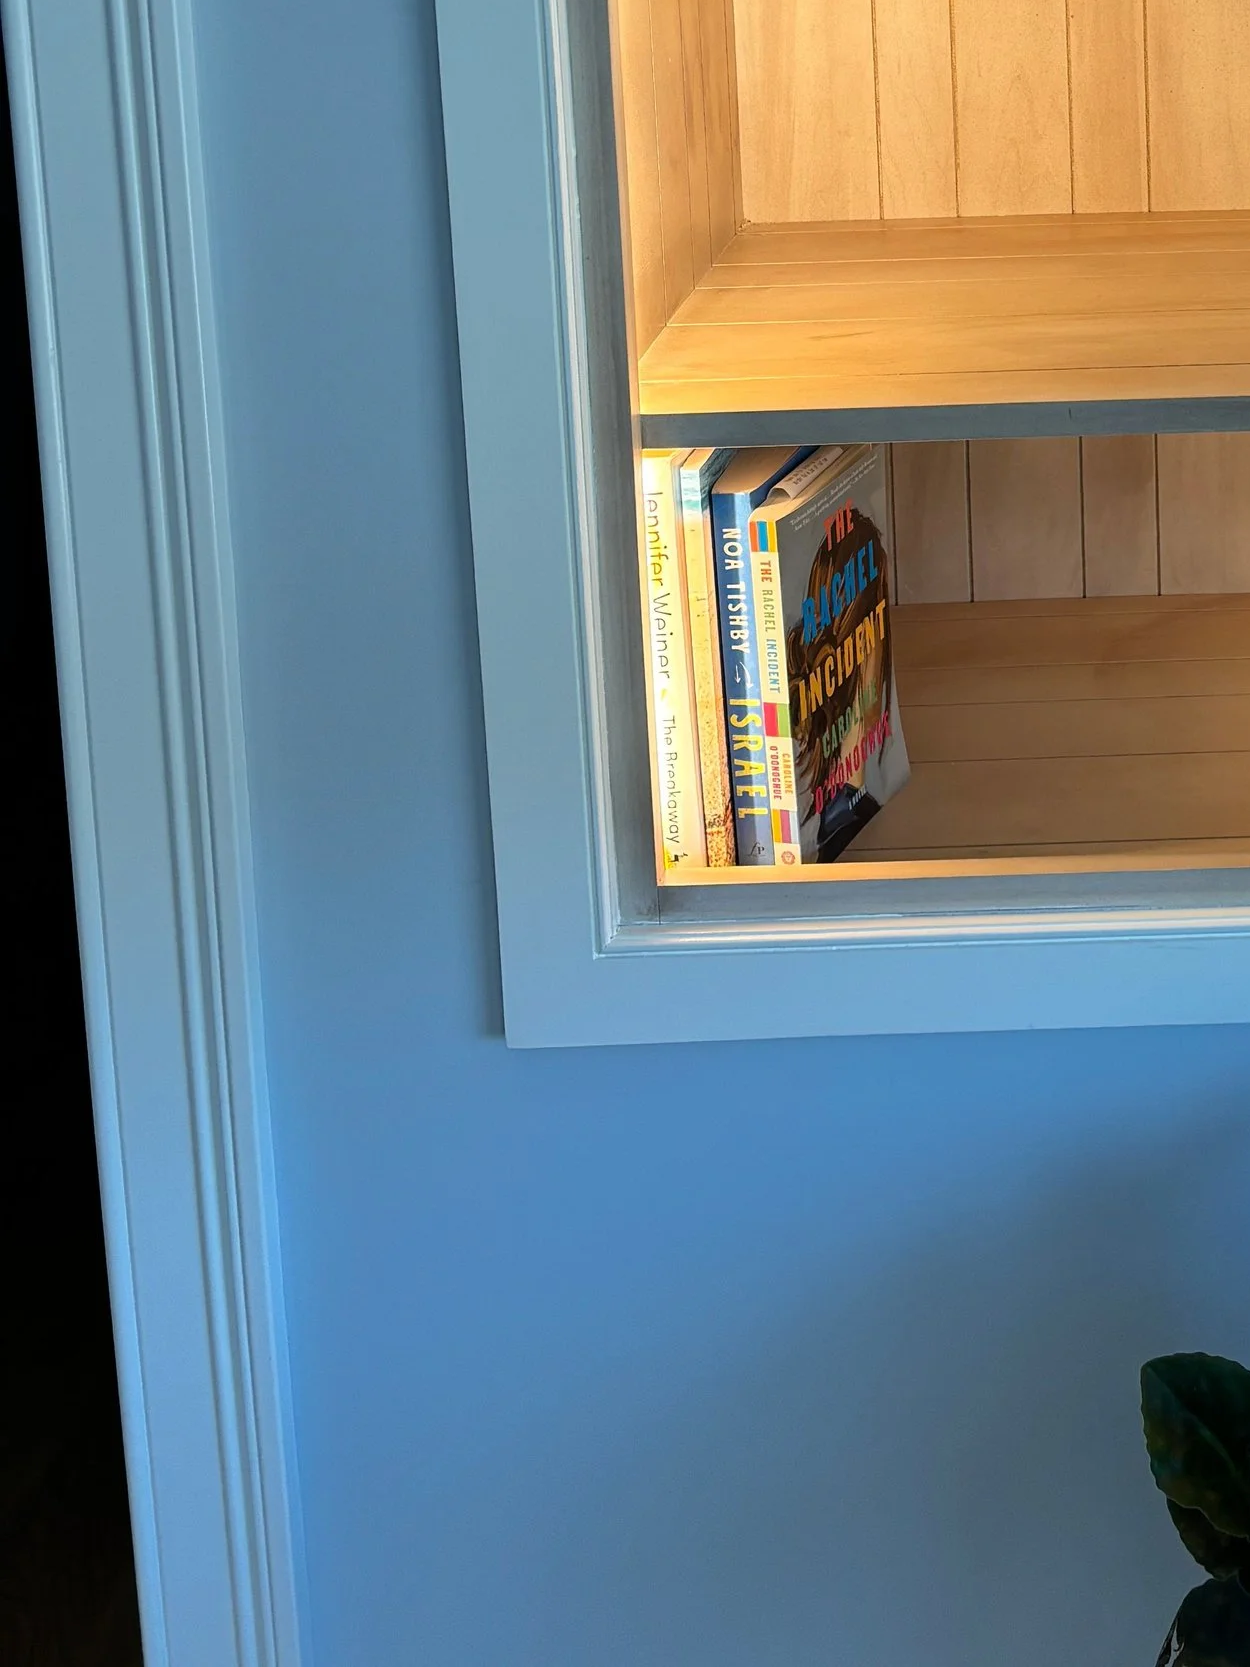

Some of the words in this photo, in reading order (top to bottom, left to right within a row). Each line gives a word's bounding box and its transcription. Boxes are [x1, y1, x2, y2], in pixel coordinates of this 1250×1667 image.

[645, 491, 669, 588] Jennifer
[721, 527, 746, 571] NOA
[823, 498, 854, 552] THE
[760, 560, 772, 583] THE
[802, 539, 879, 646] RACHEL
[653, 592, 673, 680] Weiner
[726, 580, 751, 655] TISHBY
[762, 589, 777, 633] RACHEL
[766, 638, 781, 695] INCIDENT
[799, 599, 887, 722] INCIDENT
[661, 715, 677, 747] The
[822, 678, 878, 759] CAROLINE
[728, 698, 769, 820] ISRAEL
[769, 745, 783, 801] O'DONOGHUE
[782, 753, 794, 795] CAROLINE
[814, 710, 893, 815] O'DONOGHUE
[664, 750, 683, 845] Breakaway
